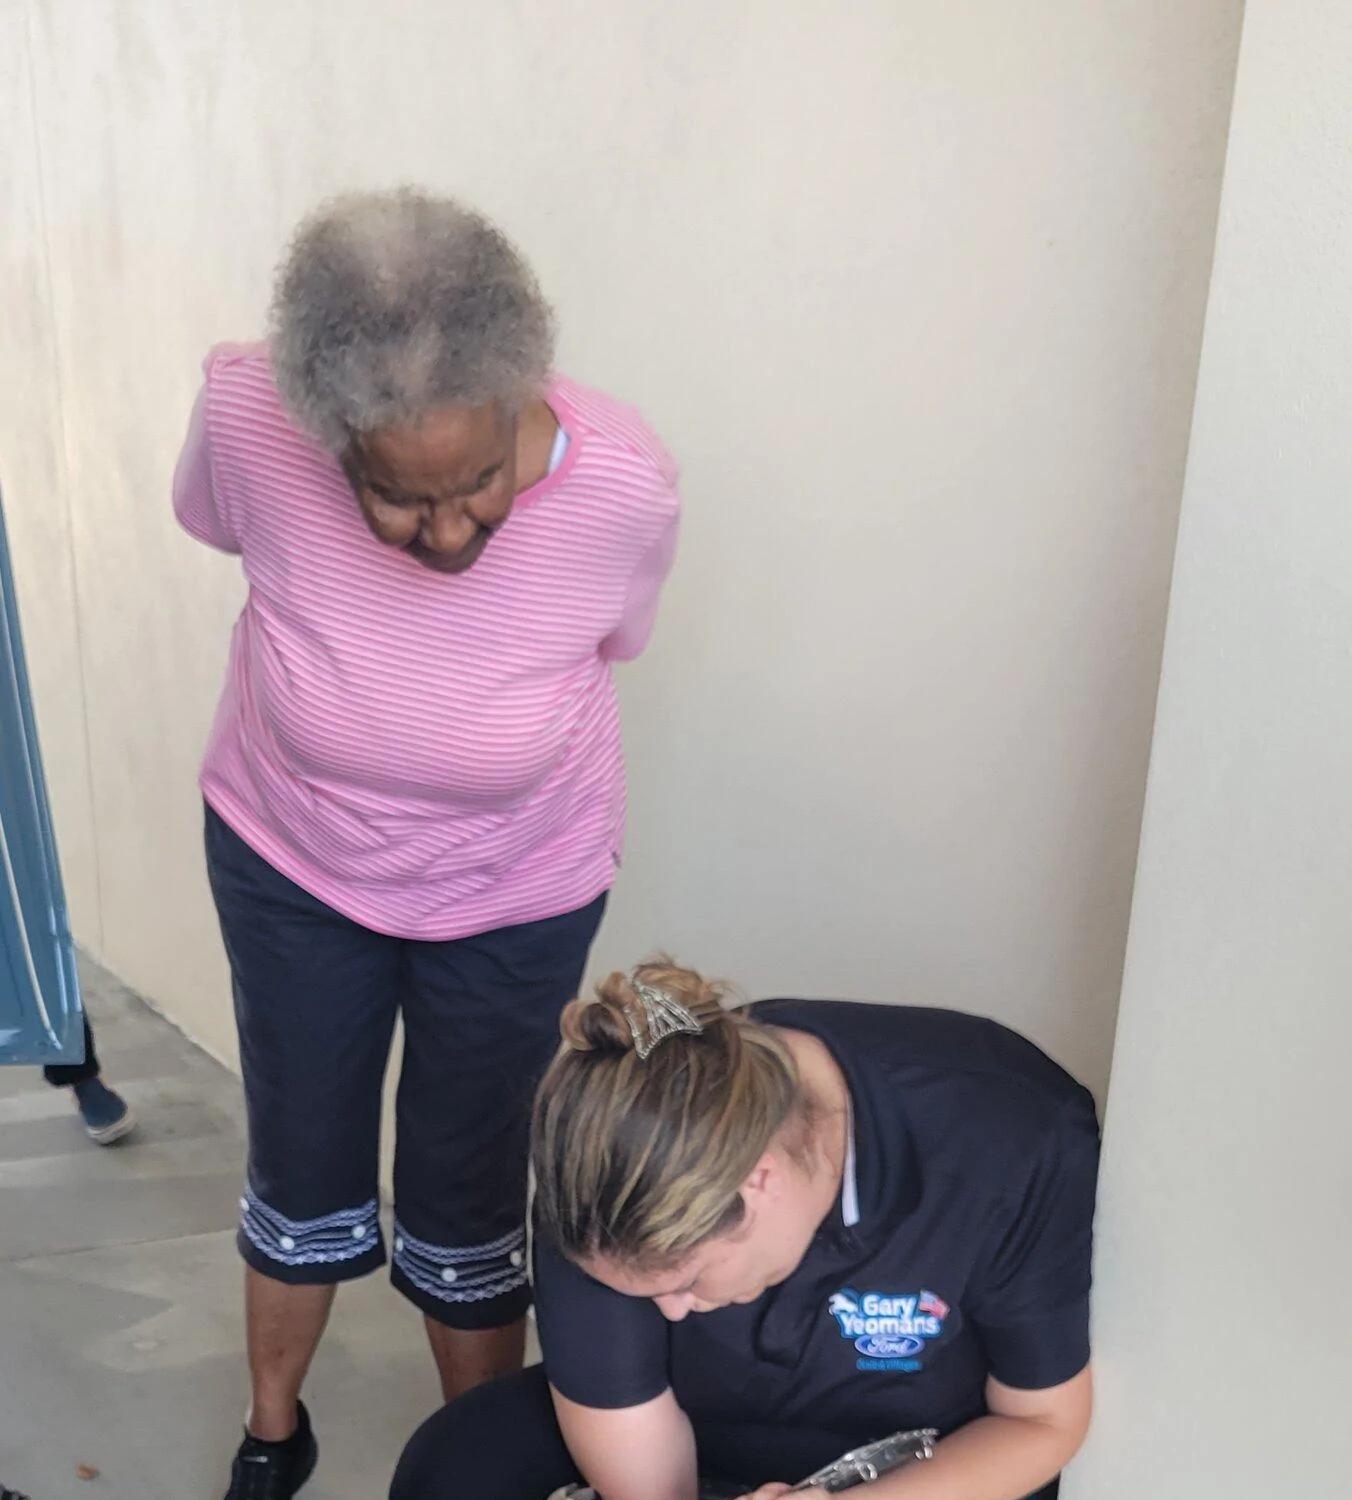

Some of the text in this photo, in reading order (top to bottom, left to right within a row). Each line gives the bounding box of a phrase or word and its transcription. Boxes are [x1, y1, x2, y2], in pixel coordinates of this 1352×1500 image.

[863, 1294, 917, 1320] Gary
[840, 1314, 939, 1335] Yeomans
[866, 1336, 910, 1354] Ford
